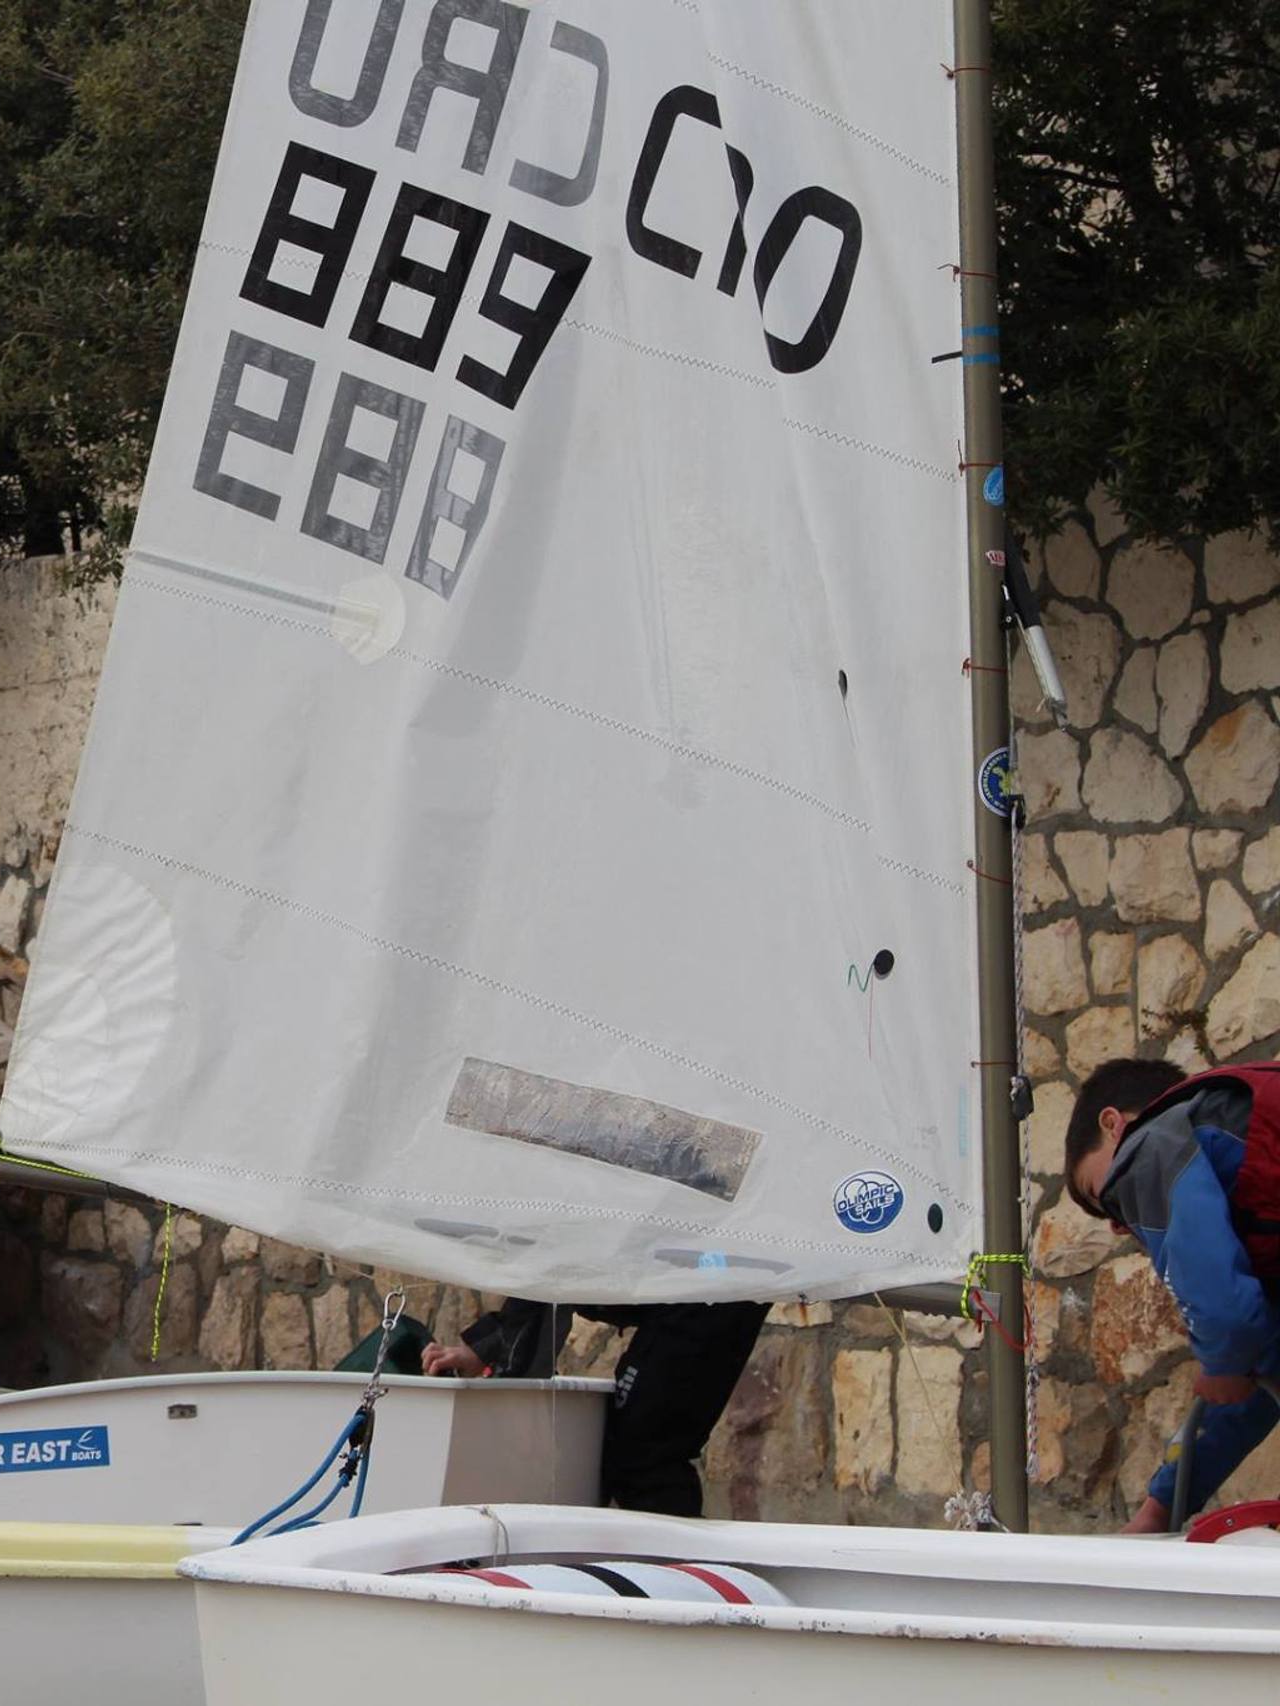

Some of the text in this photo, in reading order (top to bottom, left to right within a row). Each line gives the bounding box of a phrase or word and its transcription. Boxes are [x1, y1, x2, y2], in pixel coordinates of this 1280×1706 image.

[239, 141, 592, 411] 889
[837, 1183, 895, 1212] OLIMPIC
[854, 1196, 895, 1216] SAILS
[11, 1439, 72, 1464] EAST
[71, 1450, 102, 1462] BOATS
